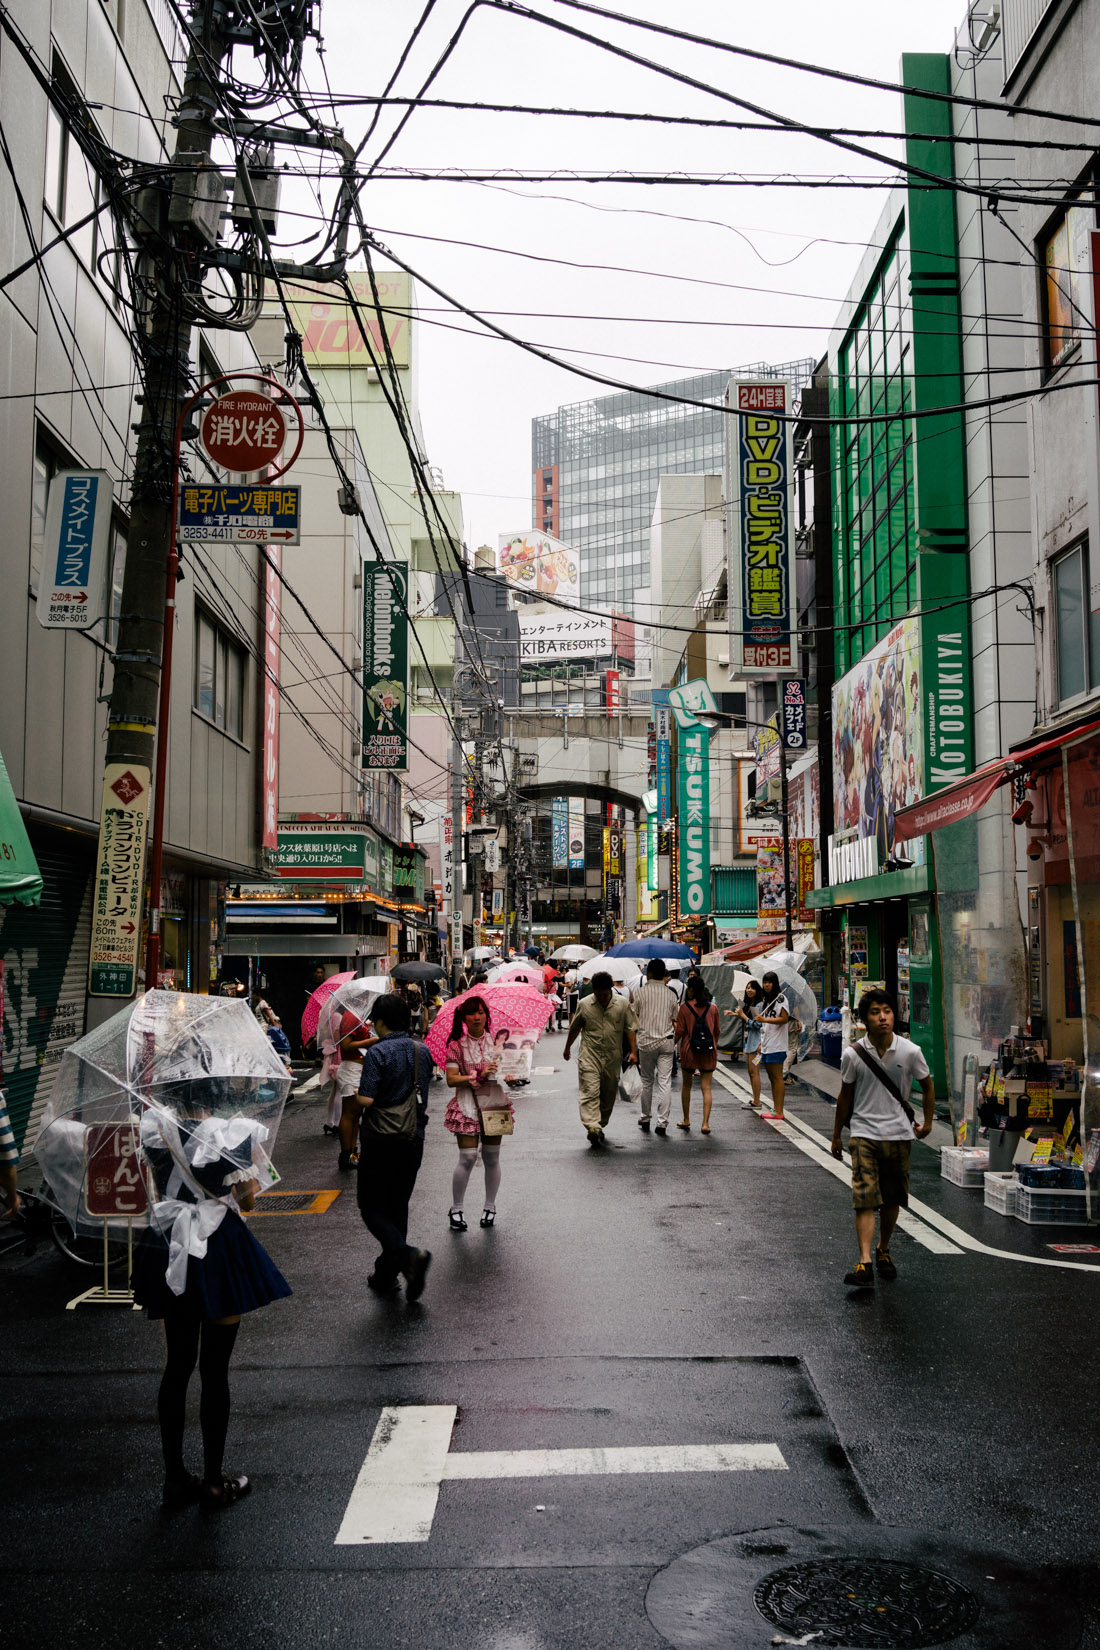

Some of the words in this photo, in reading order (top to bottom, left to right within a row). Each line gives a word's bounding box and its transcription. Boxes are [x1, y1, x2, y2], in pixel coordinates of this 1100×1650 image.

[740, 387, 784, 408] 24H営業
[218, 400, 235, 410] FIRE
[238, 402, 273, 412] HYDRANT
[210, 415, 279, 448] 消火栓
[184, 489, 297, 515] 電子パーツ専門店
[61, 478, 91, 585] コスメイトプラス
[184, 528, 233, 540] 3253-4411
[237, 529, 268, 540] この先
[50, 593, 72, 602] この先
[50, 605, 88, 614] 秋月電子5F
[48, 613, 88, 623] 3526-5013
[374, 573, 396, 676] Melonbooks
[560, 638, 607, 652] RESORTS
[744, 647, 790, 665] 受付3F
[785, 694, 804, 704] No.1
[930, 632, 966, 783] KOTOBUKIYA
[785, 705, 795, 730] カフェ
[795, 705, 804, 731] メイド
[790, 735, 801, 744] 2F
[685, 733, 704, 912] TSUKUMO
[95, 927, 117, 936] 60m
[93, 952, 134, 963] 3526-4540
[99, 972, 127, 982] 外神田
[113, 1132, 140, 1210] はんこ
